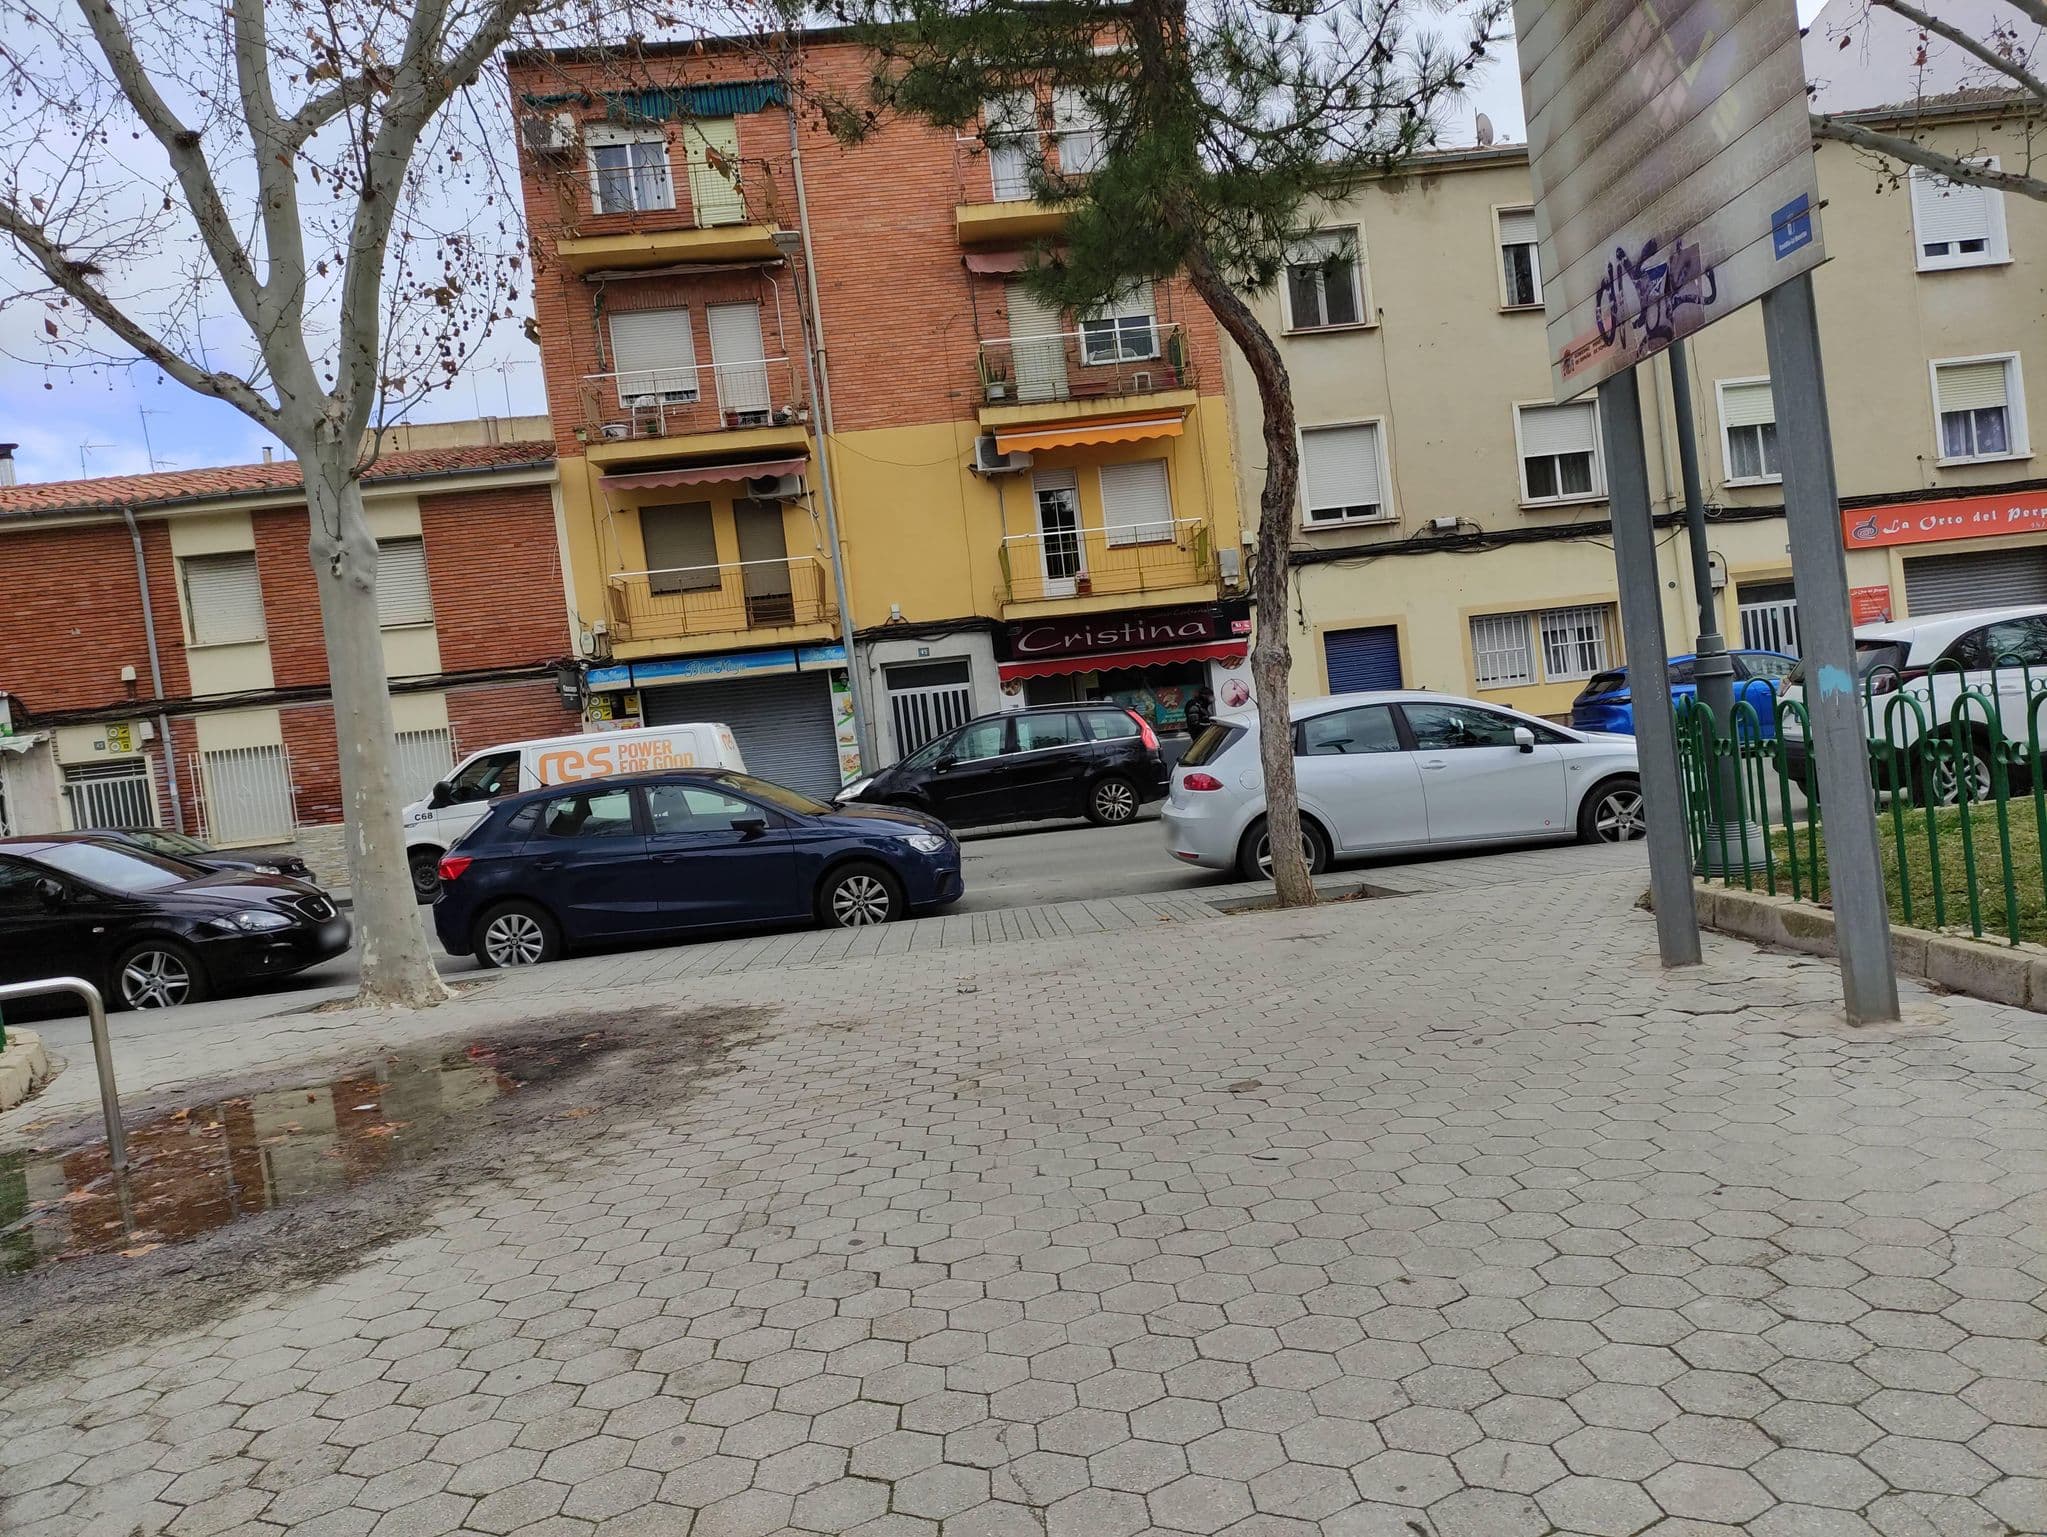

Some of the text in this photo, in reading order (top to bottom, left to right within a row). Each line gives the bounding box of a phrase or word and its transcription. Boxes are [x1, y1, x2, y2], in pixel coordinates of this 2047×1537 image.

[1882, 519, 1910, 534] La
[1972, 510, 1997, 522] del
[1017, 619, 1207, 652] Cristina
[684, 660, 714, 678] Blue
[618, 739, 672, 759] POWER
[538, 747, 614, 783] res
[619, 752, 693, 773] FOR GOOD
[414, 812, 433, 821] C68
